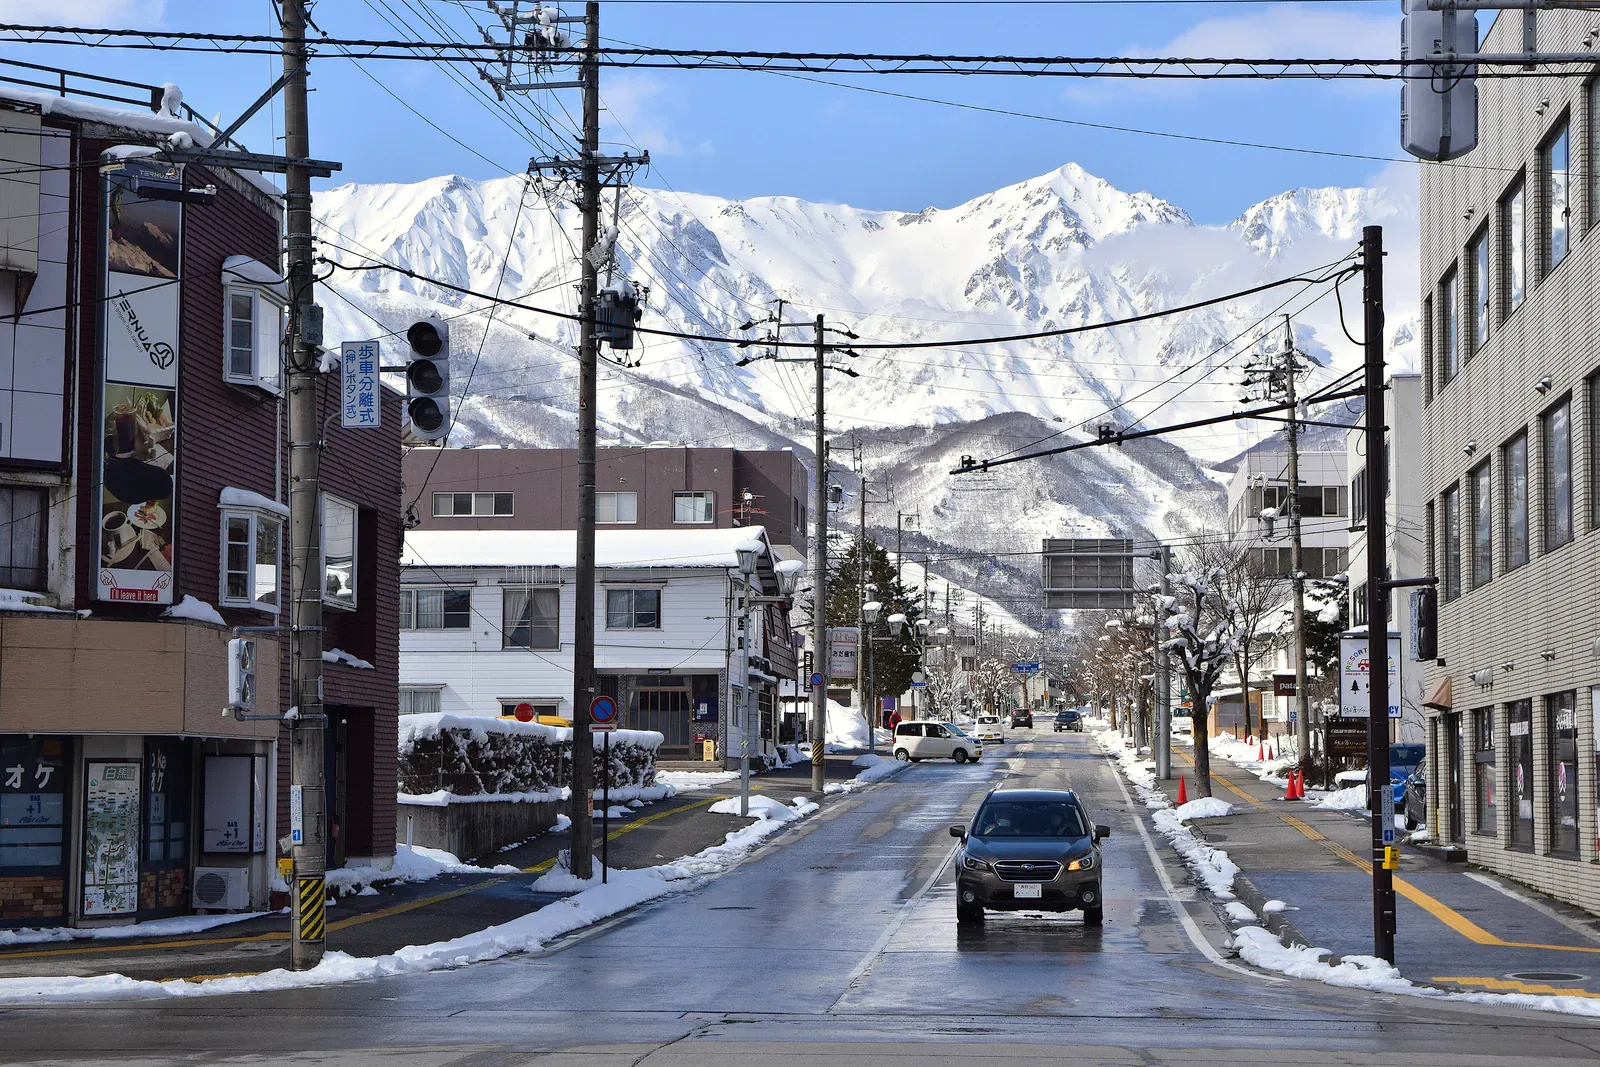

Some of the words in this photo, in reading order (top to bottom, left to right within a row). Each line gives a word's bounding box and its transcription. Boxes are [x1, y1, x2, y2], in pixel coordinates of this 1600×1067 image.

[139, 169, 169, 180] TERNUA
[118, 289, 152, 352] TERNUA
[358, 345, 375, 423] 歩車分離式
[120, 590, 136, 600] leave
[137, 591, 142, 600] it
[143, 591, 157, 601] here
[1345, 647, 1367, 671] RESORT
[1389, 706, 1399, 714] CY
[5, 763, 55, 789] オケ
[26, 801, 42, 814] +1
[223, 827, 238, 839] +1
